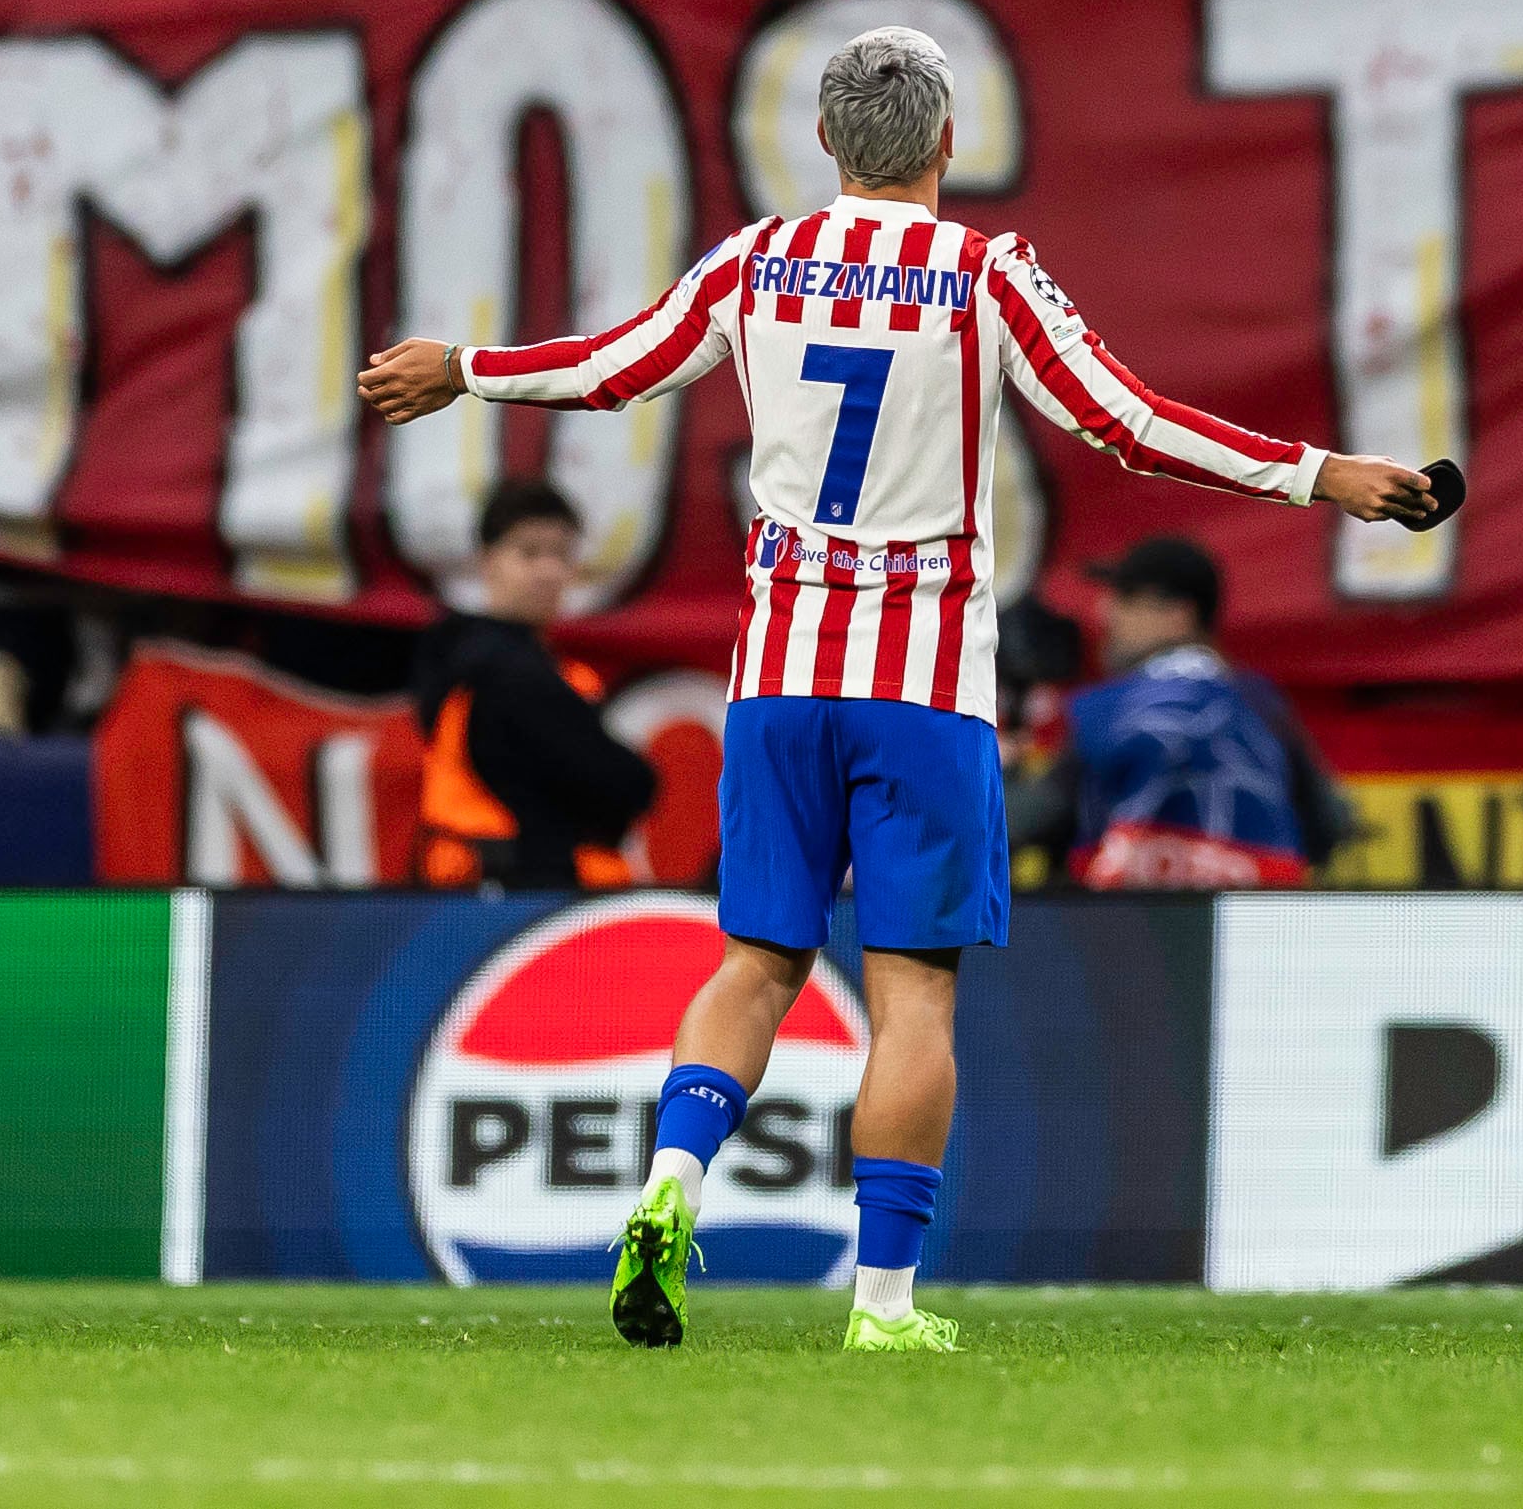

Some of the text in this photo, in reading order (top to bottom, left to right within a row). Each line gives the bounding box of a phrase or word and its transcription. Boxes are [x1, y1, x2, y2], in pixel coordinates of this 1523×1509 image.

[751, 252, 973, 311] GRIEZMANN
[798, 341, 899, 527] 7
[791, 541, 953, 575] Save the Children
